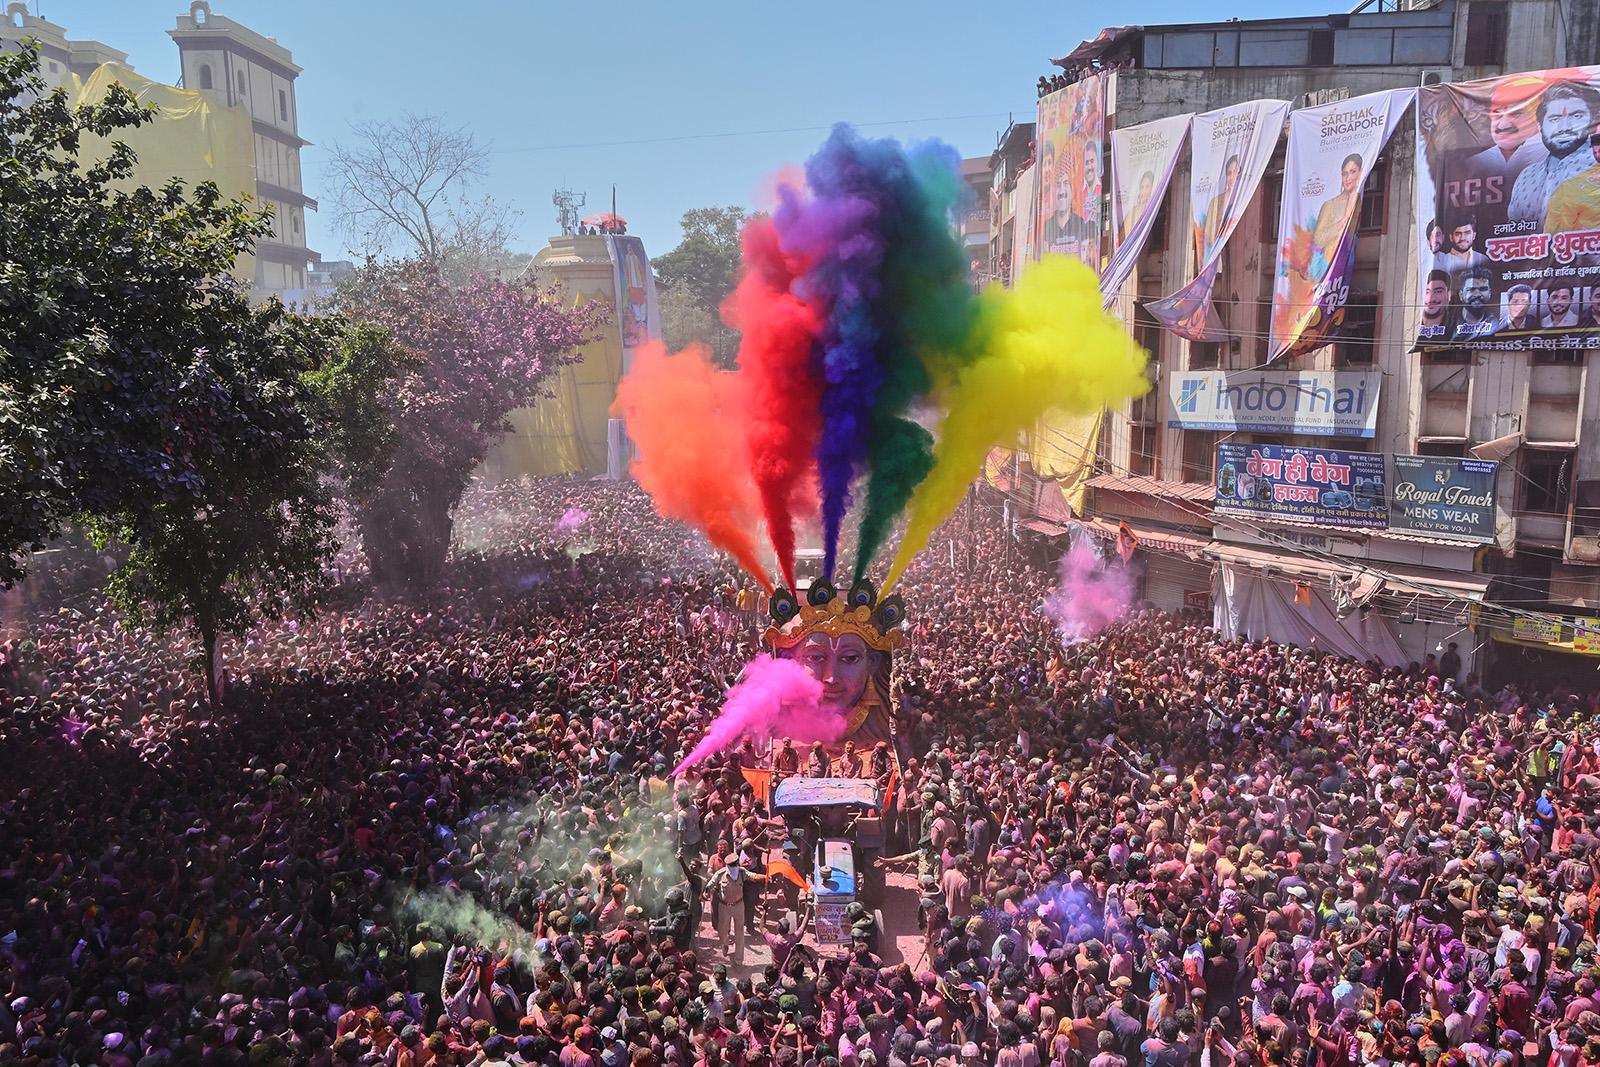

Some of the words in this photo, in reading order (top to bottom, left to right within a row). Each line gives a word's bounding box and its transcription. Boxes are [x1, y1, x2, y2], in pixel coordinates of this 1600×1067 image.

[1320, 115, 1385, 138] SINGAPORE
[1321, 107, 1374, 127] SARTHAK
[1320, 136, 1341, 147] Build
[1445, 175, 1504, 208] RGS
[1493, 220, 1517, 235] हमारे
[1486, 233, 1550, 262] रुद्राक्ष
[1513, 268, 1543, 280] जन्मदिन
[1543, 267, 1554, 278] की
[1326, 418, 1361, 426] INSURANCE
[1246, 449, 1283, 479] बेग
[1284, 452, 1309, 484] ही
[1310, 455, 1350, 486] बेग
[1273, 483, 1320, 503] हाऊस
[1395, 481, 1443, 505] Royal
[1445, 485, 1493, 507] Touch
[1403, 506, 1438, 520] MENS
[1442, 509, 1480, 524] WEAR
[1414, 521, 1434, 529] ONLY
[1435, 523, 1450, 531] FOR
[1451, 524, 1466, 533] YOU
